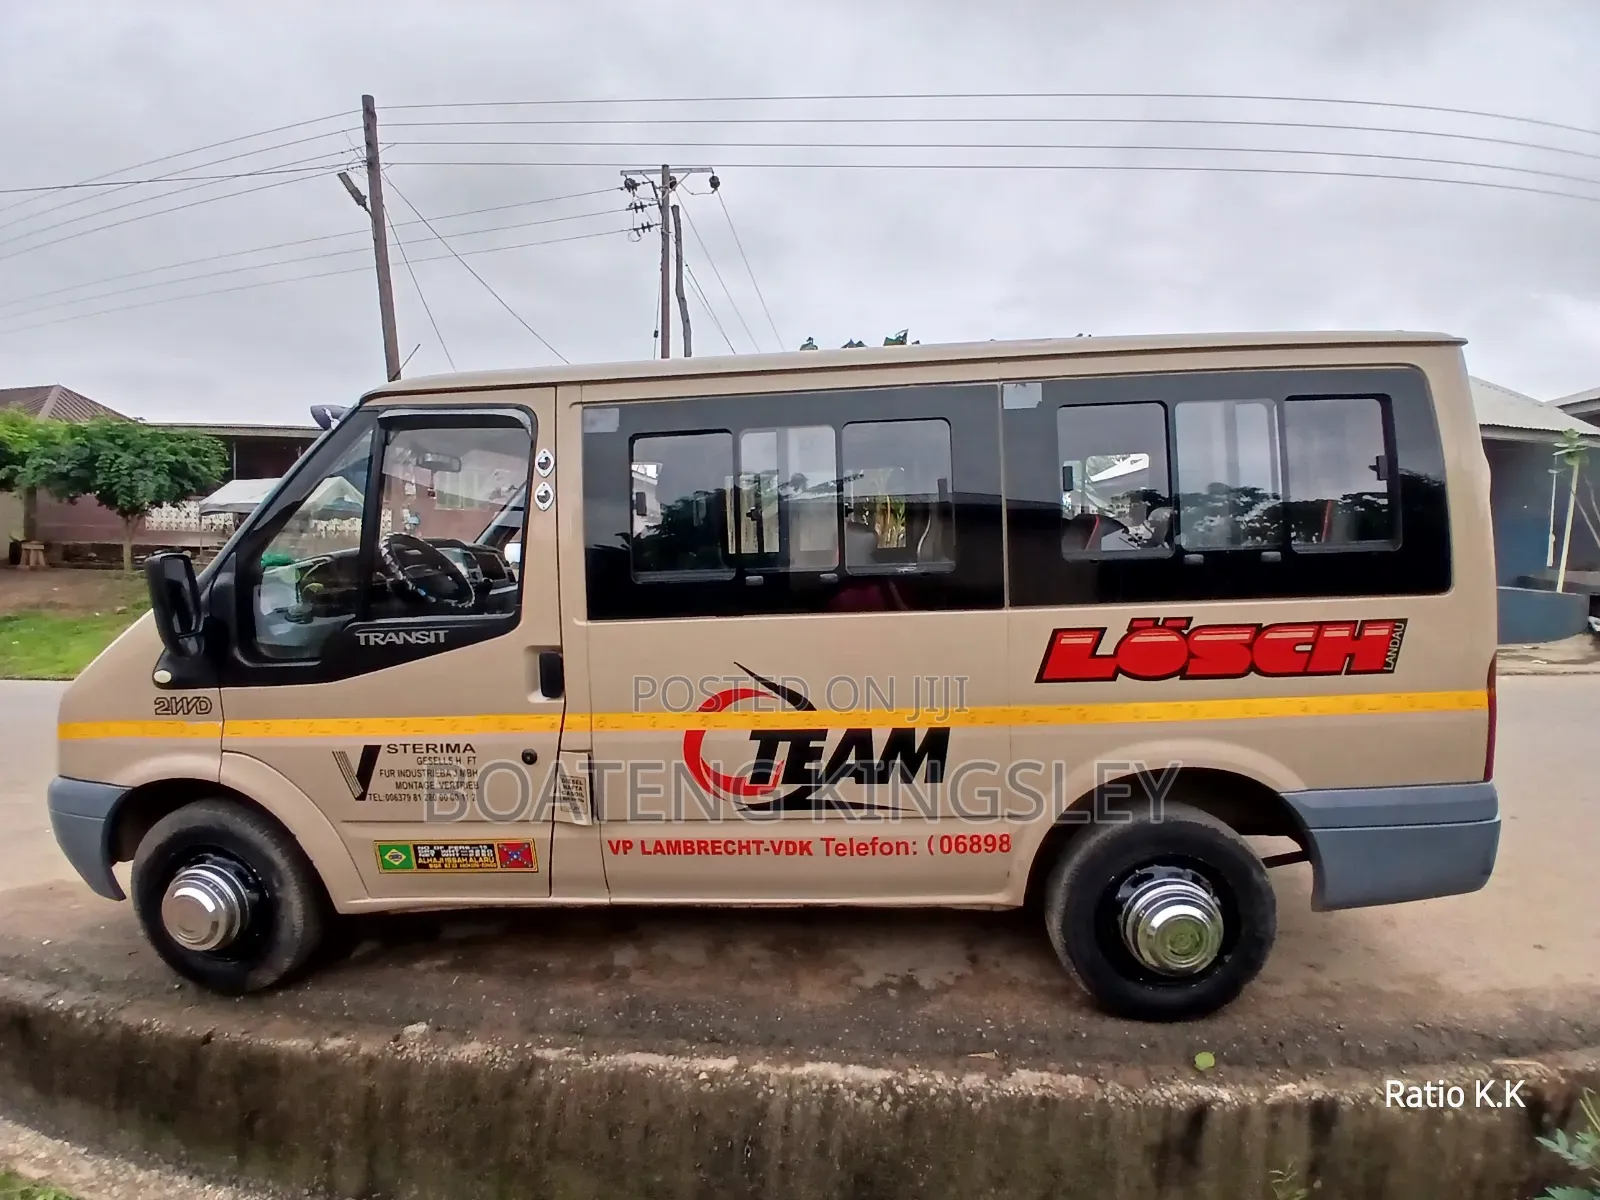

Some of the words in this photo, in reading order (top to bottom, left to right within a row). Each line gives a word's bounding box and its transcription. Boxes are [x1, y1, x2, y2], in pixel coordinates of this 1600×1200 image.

[355, 629, 449, 647] TRANSIT
[1383, 622, 1405, 671] LANDAU
[1035, 617, 1400, 683] LÖSCH
[153, 695, 213, 716] 2WD
[386, 743, 476, 754] STERIMA
[749, 726, 950, 784] TEAM
[395, 781, 435, 790] MONTAGE
[607, 840, 633, 855] VP
[640, 840, 814, 856] LAMBRECHT-VDK
[820, 837, 918, 857] Telefon:
